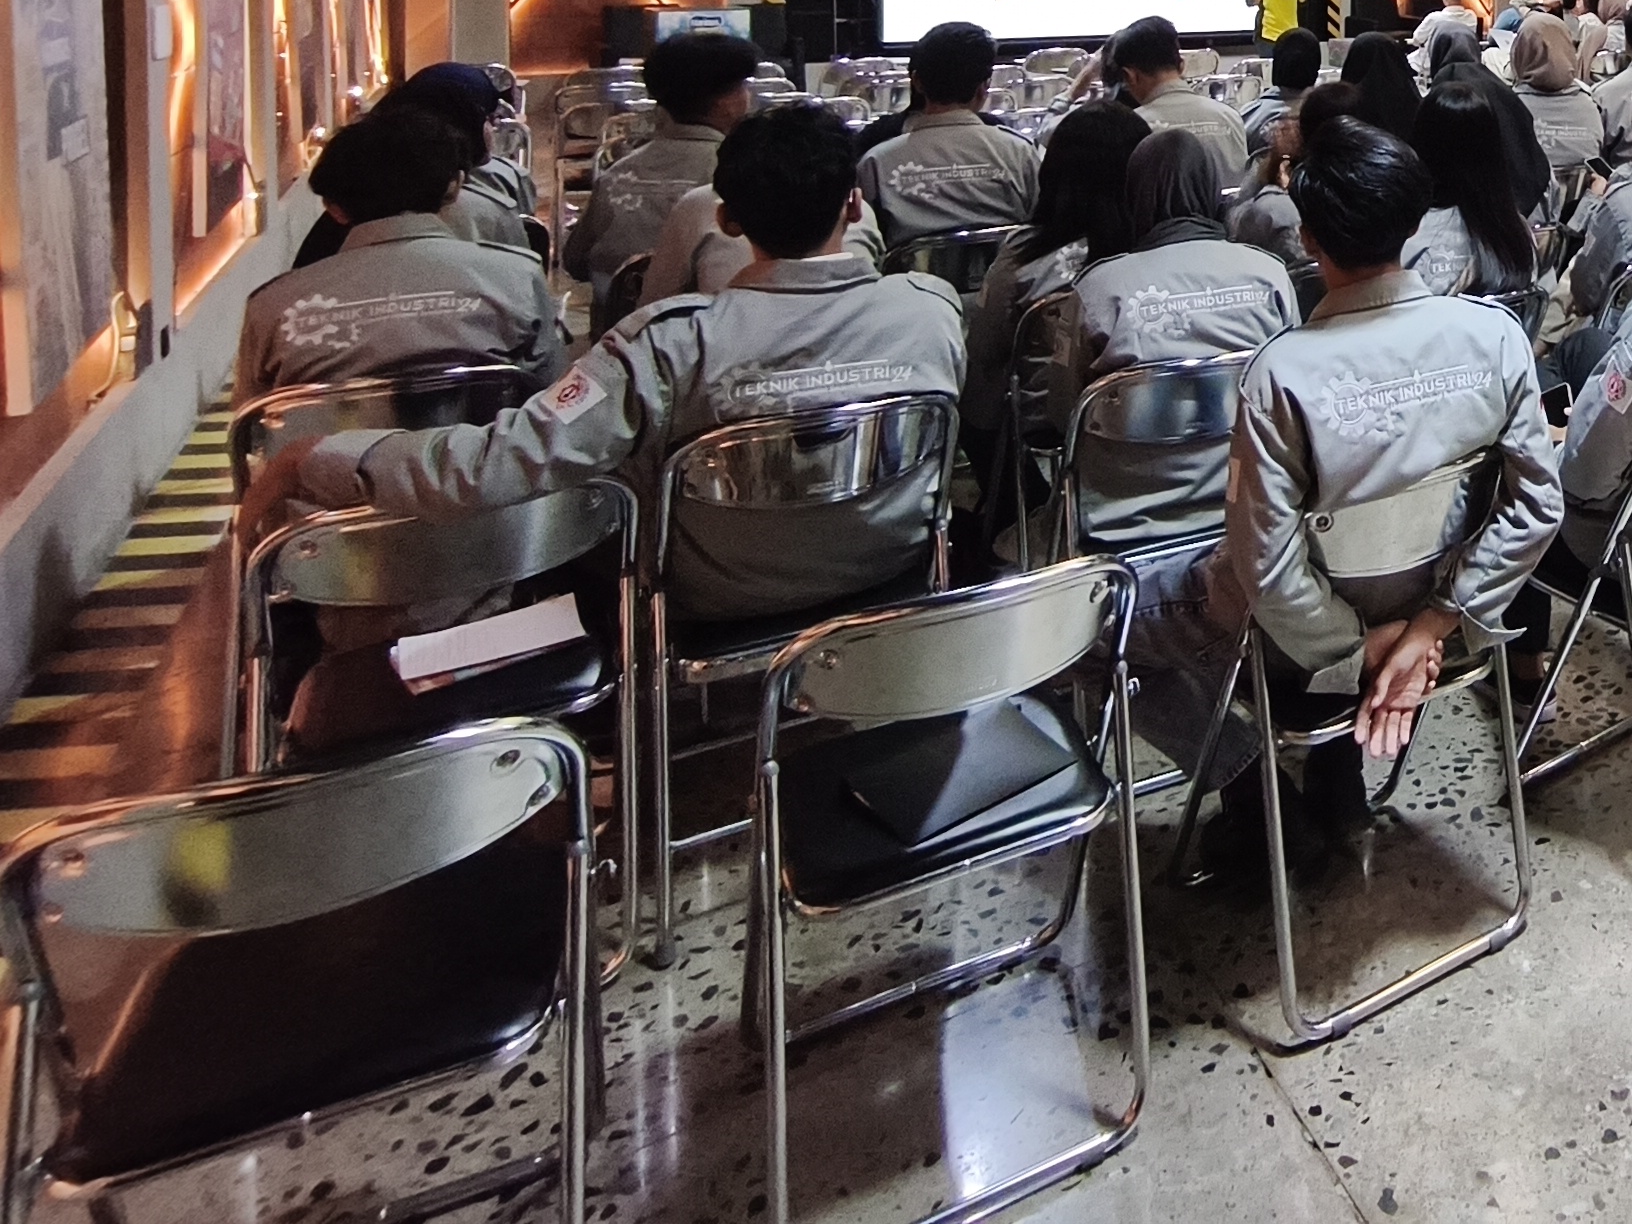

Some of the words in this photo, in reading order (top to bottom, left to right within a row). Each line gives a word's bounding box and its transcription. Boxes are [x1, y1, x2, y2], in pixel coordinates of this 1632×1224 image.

[298, 307, 363, 325] TEKNIK
[370, 296, 456, 317] INDUSTRI
[1140, 300, 1190, 317] TEKNIK
[1194, 290, 1255, 308] INDUSTRI
[735, 377, 799, 397] TEKNIK
[806, 366, 890, 388] INDUSTRI
[1335, 389, 1396, 414] TEKNIK
[1399, 373, 1474, 401] INDUSTRI
